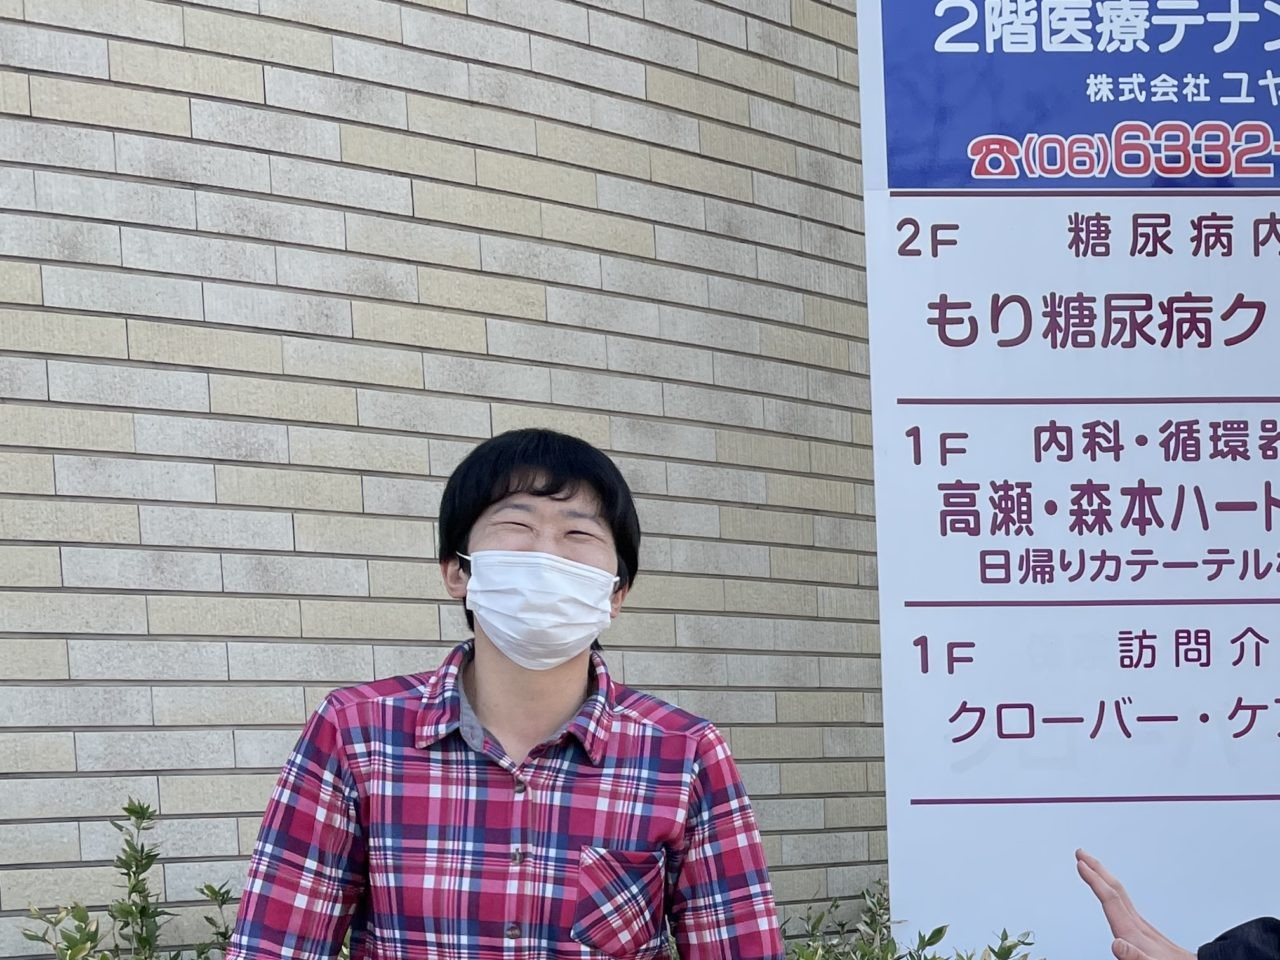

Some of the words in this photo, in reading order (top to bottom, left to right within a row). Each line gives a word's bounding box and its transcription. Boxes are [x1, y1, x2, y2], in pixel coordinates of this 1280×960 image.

[1087, 74, 1210, 102] 株式会社
[897, 218, 959, 257] 2F
[906, 426, 968, 466] 1F
[913, 636, 975, 674] 1F
